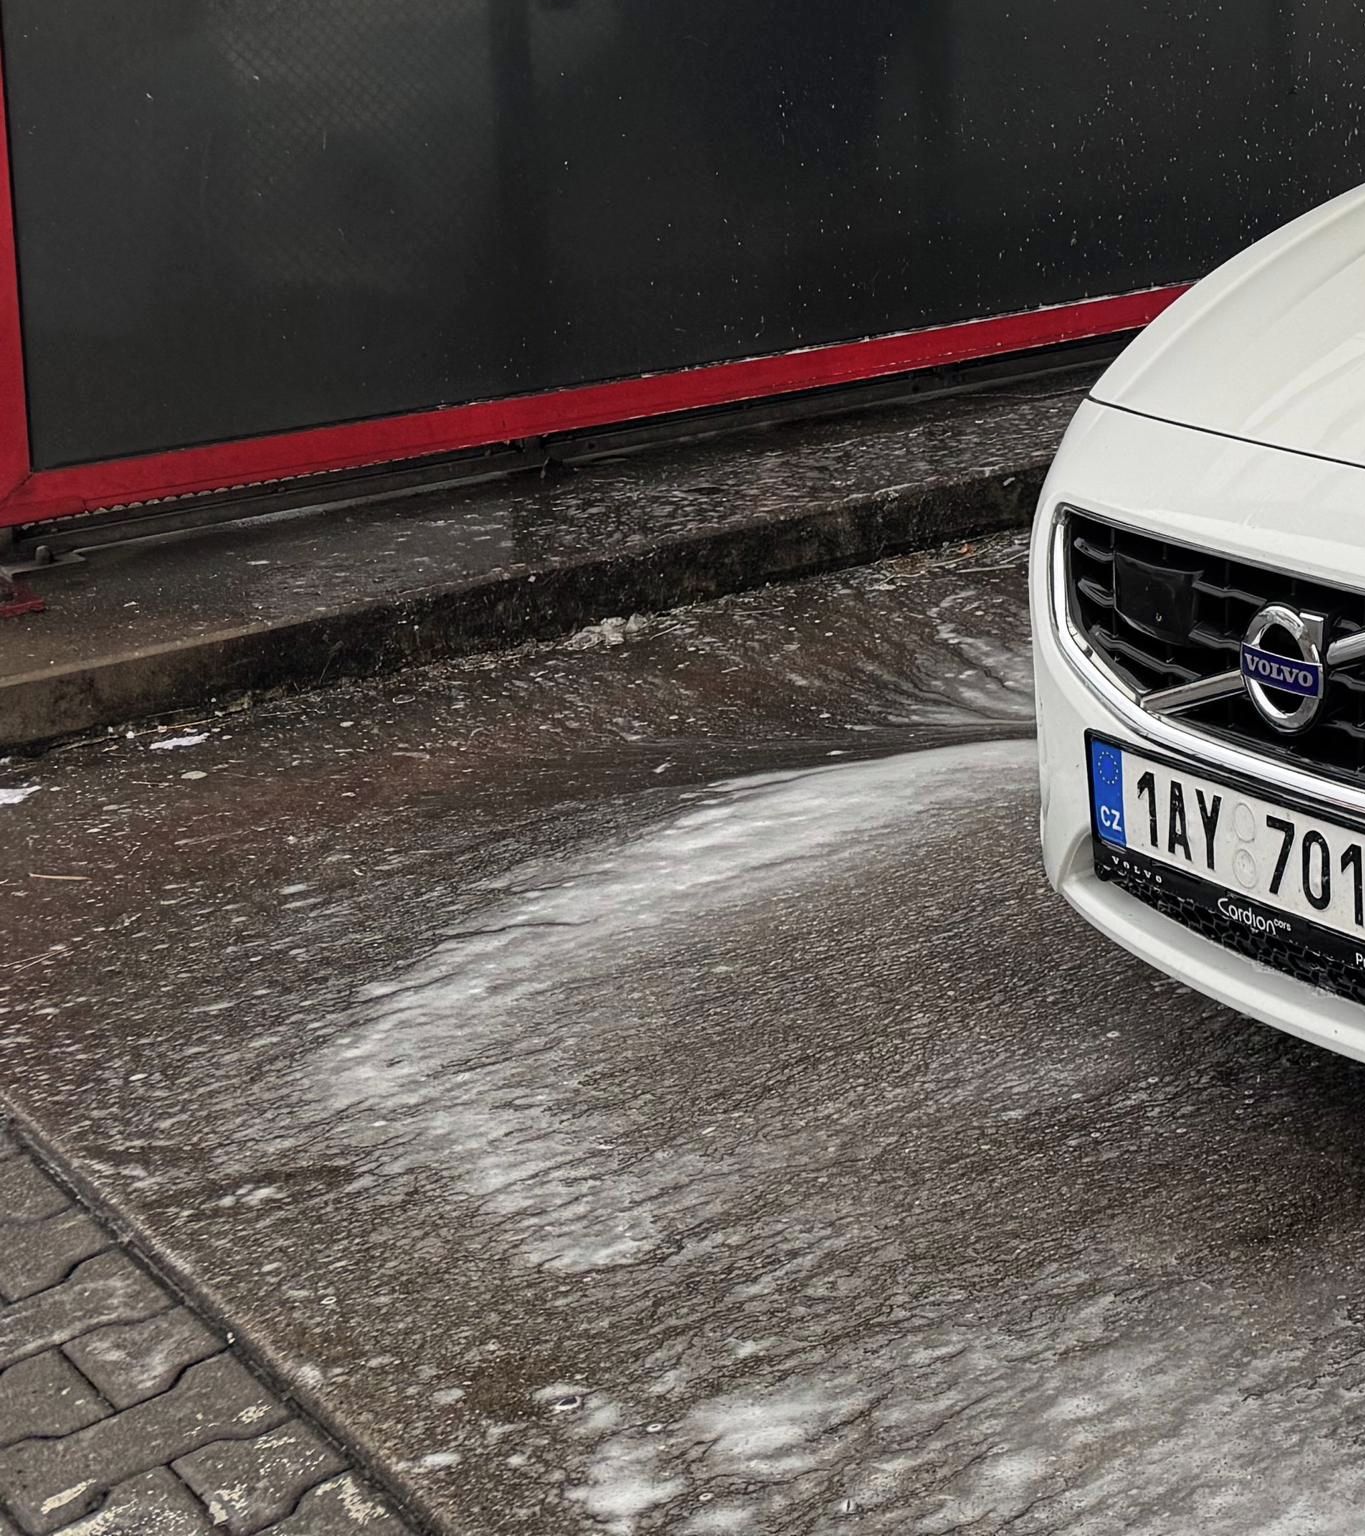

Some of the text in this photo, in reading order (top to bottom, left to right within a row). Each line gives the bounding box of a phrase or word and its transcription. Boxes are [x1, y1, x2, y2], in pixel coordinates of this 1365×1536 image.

[1244, 652, 1314, 687] VOLVO
[1100, 804, 1122, 833] CZ
[1136, 770, 1223, 871] 1AY
[1111, 855, 1163, 884] VOLVO
[1217, 897, 1277, 936] Cardion
